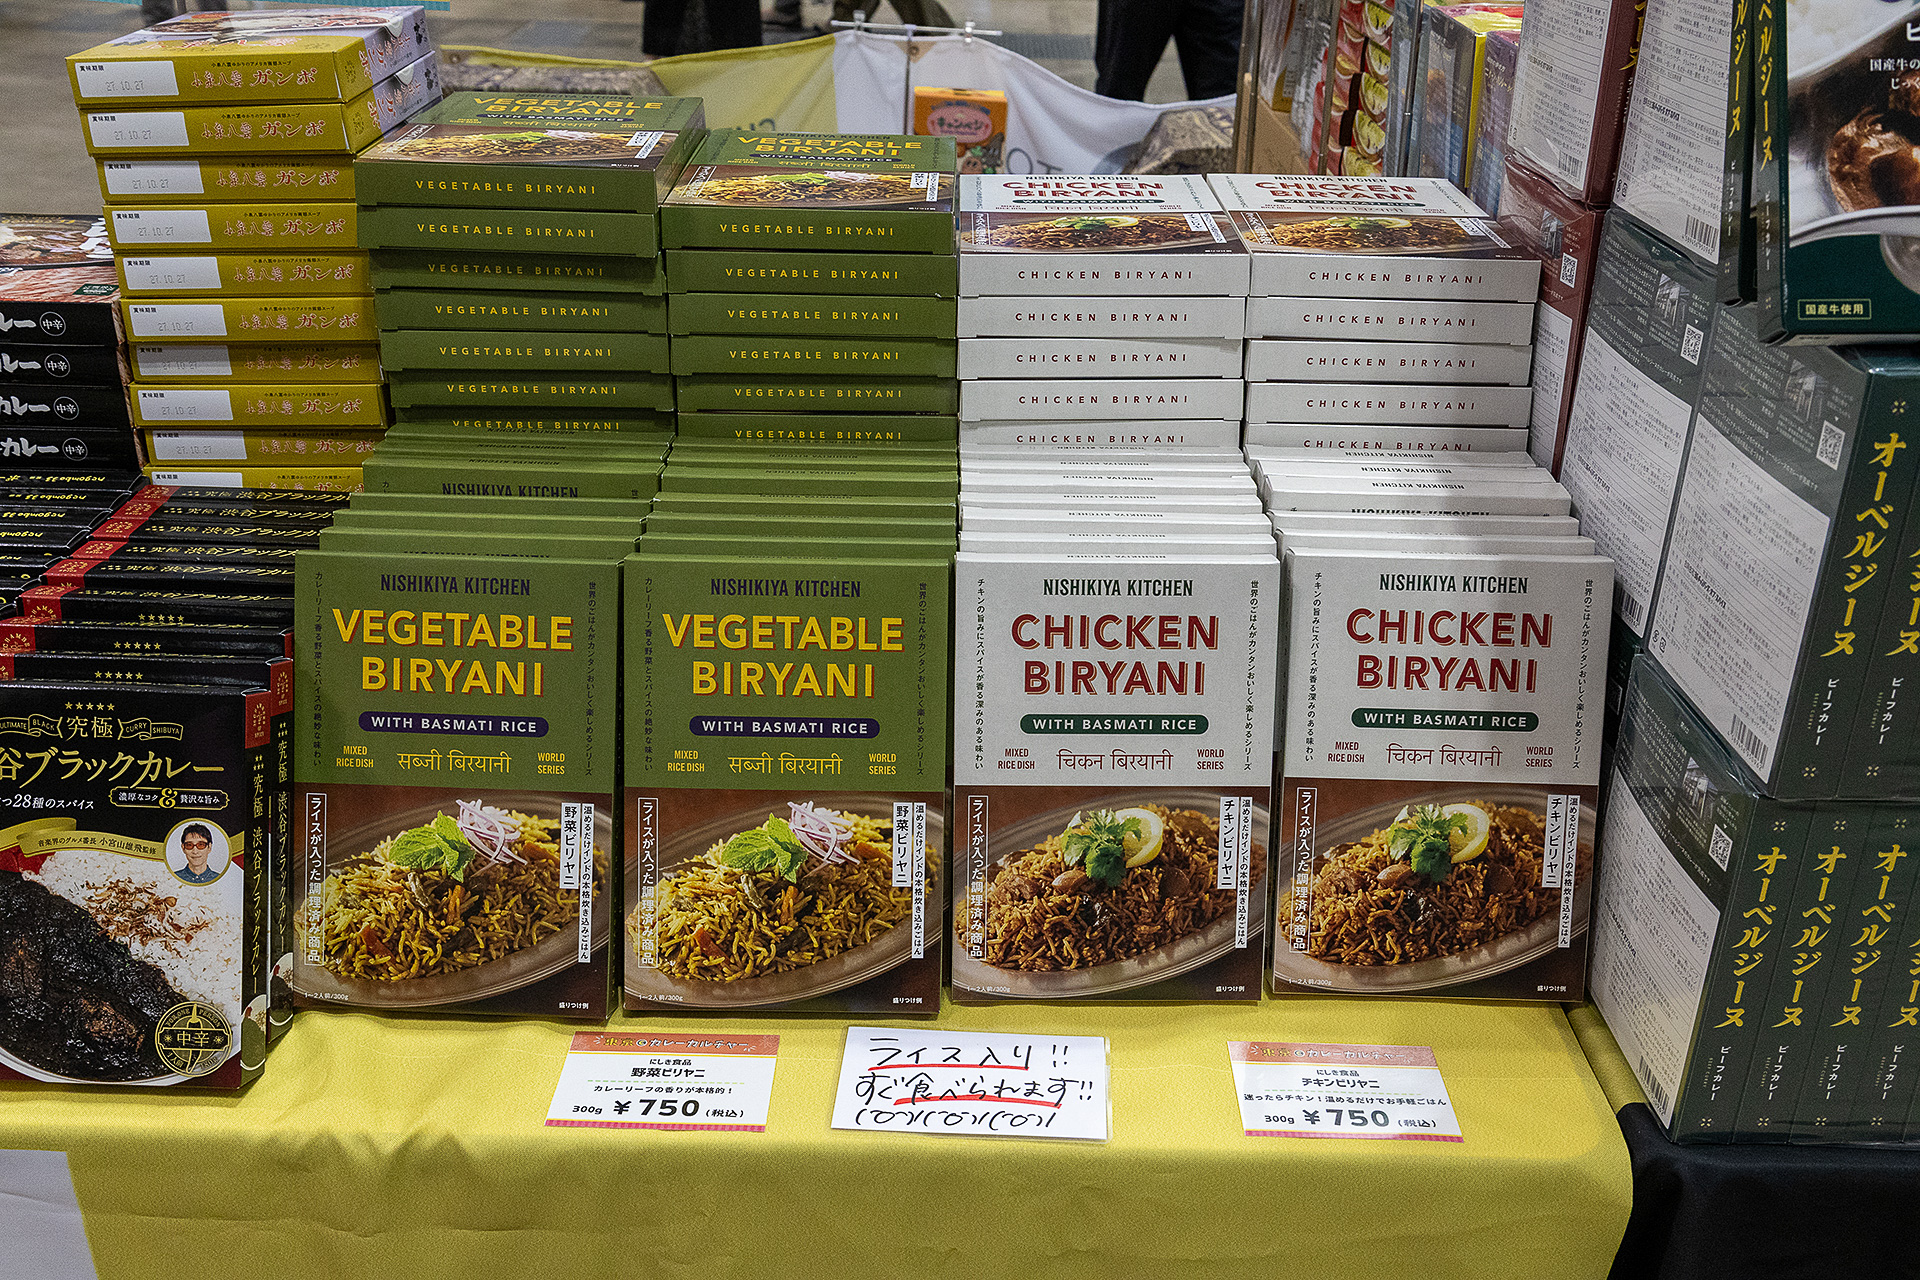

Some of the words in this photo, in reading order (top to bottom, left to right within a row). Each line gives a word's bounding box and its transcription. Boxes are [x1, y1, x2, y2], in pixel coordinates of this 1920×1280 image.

[473, 97, 663, 110] VEGETABLE
[491, 105, 637, 116] BIRYANI
[738, 137, 922, 149] VEGETABLE
[755, 144, 902, 156] BIRYANI
[416, 180, 514, 192] VEGETABLE
[525, 184, 596, 194] BIRYANI
[1002, 182, 1163, 190] CHICKEN
[1254, 182, 1417, 193] CHICKEN
[1269, 190, 1416, 200] BIRYANI
[719, 224, 814, 235] VEGETABLE
[826, 226, 894, 236] BIRYANI
[725, 269, 819, 278] VEGETABLE
[831, 270, 898, 280] BIRYANI
[1018, 271, 1100, 280] CHICKEN
[1114, 271, 1192, 280] BIRYANI
[1309, 271, 1391, 282] CHICKEN
[1405, 273, 1483, 284] BIRYANI
[435, 305, 530, 315] VEGETABLE
[541, 307, 608, 316] BIRYANI
[1805, 303, 1864, 315] 国産牛使用
[447, 384, 540, 394] VEGETABLE
[551, 385, 617, 395] BIRYANI
[1018, 396, 1098, 404] CHICKEN
[1112, 395, 1188, 404] BIRYANI
[735, 430, 826, 439] VEGETABLE
[837, 431, 902, 440] BIRYANI
[1303, 439, 1384, 450] CHICKEN
[1396, 441, 1472, 451] BIRYANI
[442, 483, 512, 497] NISHIKIYA
[1820, 432, 1906, 657] オーベルジーヌ
[380, 574, 459, 594] NISHIKIYA
[464, 577, 531, 596] KITCHEN
[711, 578, 789, 597] NISHIKIYA
[794, 580, 861, 598] KITCHEN
[1043, 578, 1121, 597] NISHIKIYA
[1127, 579, 1193, 597] KITCHEN
[1379, 573, 1456, 592] NISHIKIYA
[1462, 576, 1528, 594] KITCHEN
[332, 608, 574, 651] VEGETABLE
[662, 613, 905, 652] VEGETABLE
[1011, 613, 1219, 651] CHICKEN
[1346, 607, 1553, 648] CHICKEN
[362, 657, 544, 697] BIRYANI
[692, 660, 875, 699] BIRYANI
[1024, 660, 1205, 696] BIRYANI
[1356, 654, 1537, 694] BIRYANI
[1815, 678, 1840, 745] ビーフカレー
[1879, 677, 1904, 744] ビーフカレー
[32, 719, 55, 731] BLACK
[371, 716, 413, 729] WITH
[421, 718, 493, 732] BASMATI
[501, 720, 537, 733] RICE
[1033, 719, 1074, 730] WITH
[1082, 719, 1153, 731] BASMATI
[1161, 719, 1197, 731] RICE
[1364, 712, 1405, 725] WITH
[1413, 714, 1484, 727] BASMATI
[1491, 716, 1527, 728] RICE
[66, 716, 113, 741] 究極
[125, 722, 148, 733] CURRY
[152, 727, 180, 735] SHIBUYA
[702, 720, 744, 733] WITH
[752, 722, 824, 734] BASMATI
[832, 723, 868, 735] RICE
[343, 746, 368, 755] MIXED
[674, 749, 699, 760] MIXED
[1004, 748, 1029, 758] MIXED
[1197, 749, 1224, 759] WORLD
[1439, 744, 1503, 768] बिरयानी
[336, 757, 355, 768] RICE
[356, 757, 374, 768] DISH
[447, 749, 512, 774] बिरयानी
[537, 752, 565, 763] WORLD
[778, 752, 843, 776] बिरयानी
[869, 753, 897, 763] WORLD
[1110, 748, 1174, 771] बिरयानी
[537, 764, 565, 775] SERIES
[667, 761, 686, 772] RICE
[687, 762, 705, 773] DISH
[868, 764, 897, 776] SERIES
[998, 760, 1016, 770] RICE
[1017, 760, 1035, 770] DISH
[1197, 760, 1224, 770] SERIES
[118, 791, 158, 802] 濃厚なコク
[562, 805, 578, 886] 野菜ビリヤニ
[894, 805, 910, 884] 野菜ビリヤニ
[1220, 799, 1236, 887] チキンビリヤニ
[1545, 797, 1563, 885] チキンビリヤニ
[307, 797, 322, 963] ライスが入った調理済み商品
[641, 801, 655, 965] ライスが入った調理済み商品
[970, 800, 984, 958] ライスが入った調理済み商品
[1714, 846, 1788, 1029] オーベルジーヌ
[1772, 846, 1847, 1028] オーベルジーヌ
[1830, 844, 1908, 1027] オーベルジーヌ
[177, 1030, 210, 1047] 中辛
[649, 1058, 692, 1066] にしき食品
[631, 1067, 706, 1078] 野菜ビリヤニ
[1316, 1069, 1360, 1077] にしき食品
[1710, 1045, 1732, 1101] ビーフカレー
[1825, 1044, 1848, 1100] ビーフカレー
[1302, 1078, 1380, 1089] チキンビリヤニ
[572, 1105, 603, 1115] 300g
[1264, 1114, 1295, 1124] 300g
